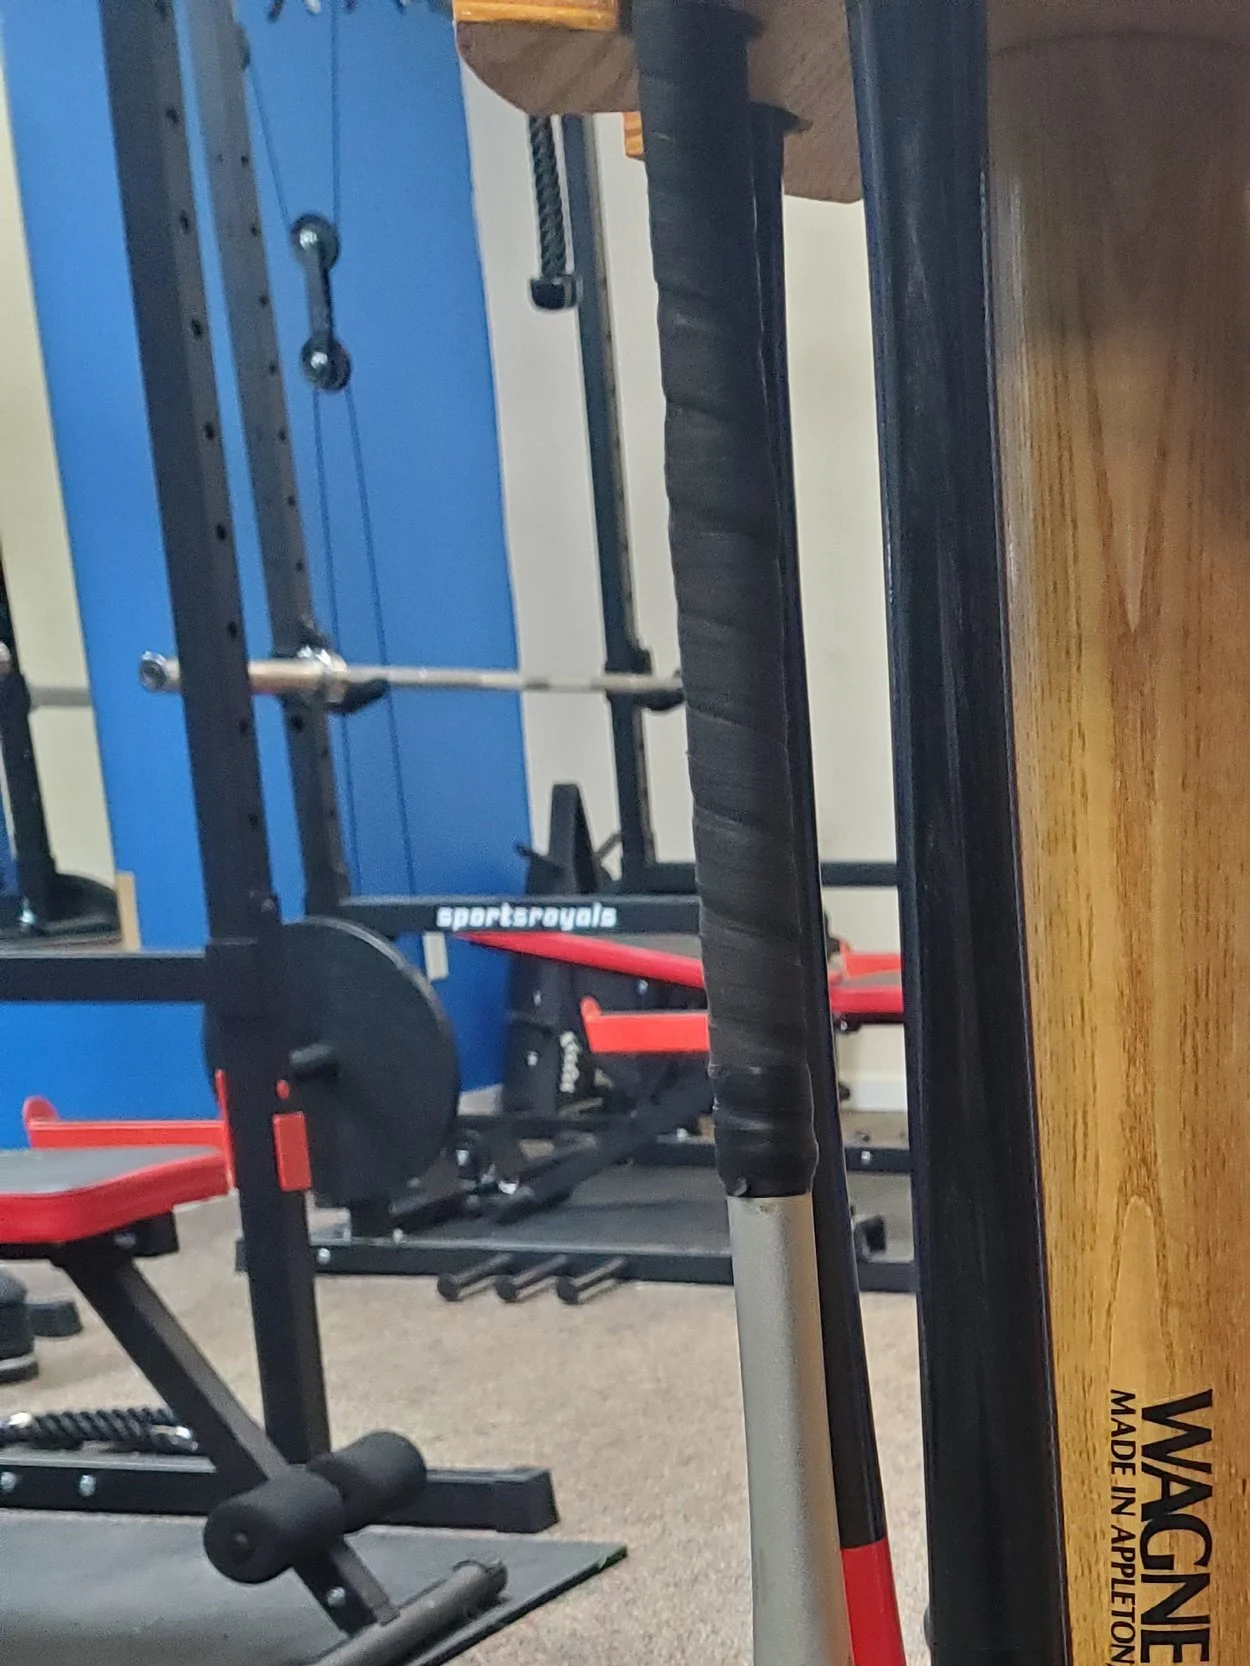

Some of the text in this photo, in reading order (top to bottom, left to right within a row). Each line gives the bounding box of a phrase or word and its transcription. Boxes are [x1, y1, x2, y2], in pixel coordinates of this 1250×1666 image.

[436, 902, 617, 931] sportsroyals
[1110, 1389, 1136, 1475] MADE
[1111, 1486, 1136, 1516] IN
